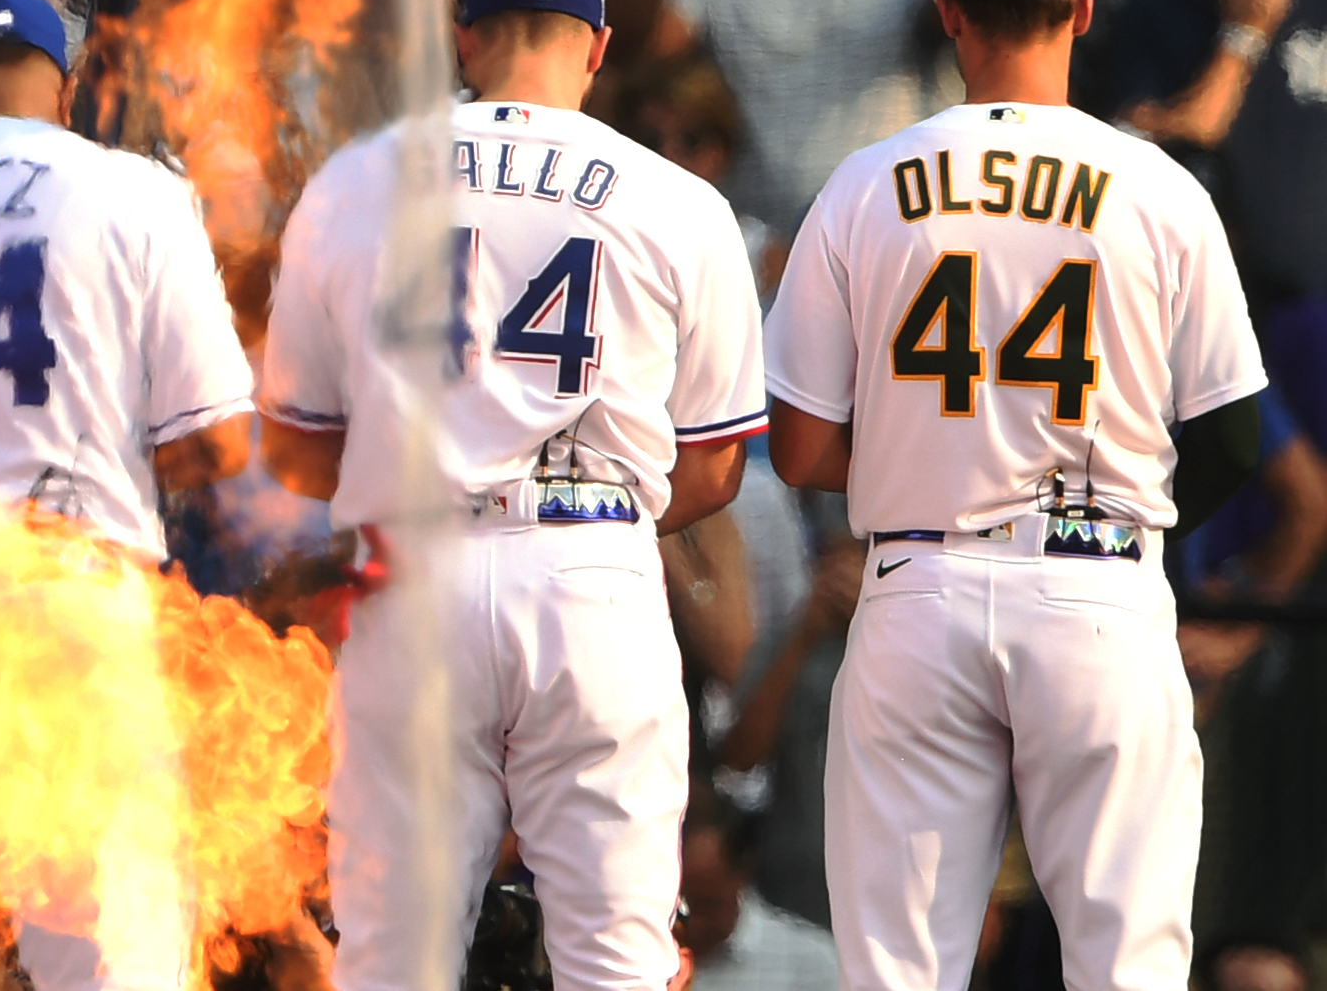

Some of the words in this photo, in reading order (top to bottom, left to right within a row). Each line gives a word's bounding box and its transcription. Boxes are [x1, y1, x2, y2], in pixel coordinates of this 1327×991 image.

[450, 138, 620, 212] ALLO
[891, 149, 1112, 234] OLSON
[889, 251, 1100, 426] 44
